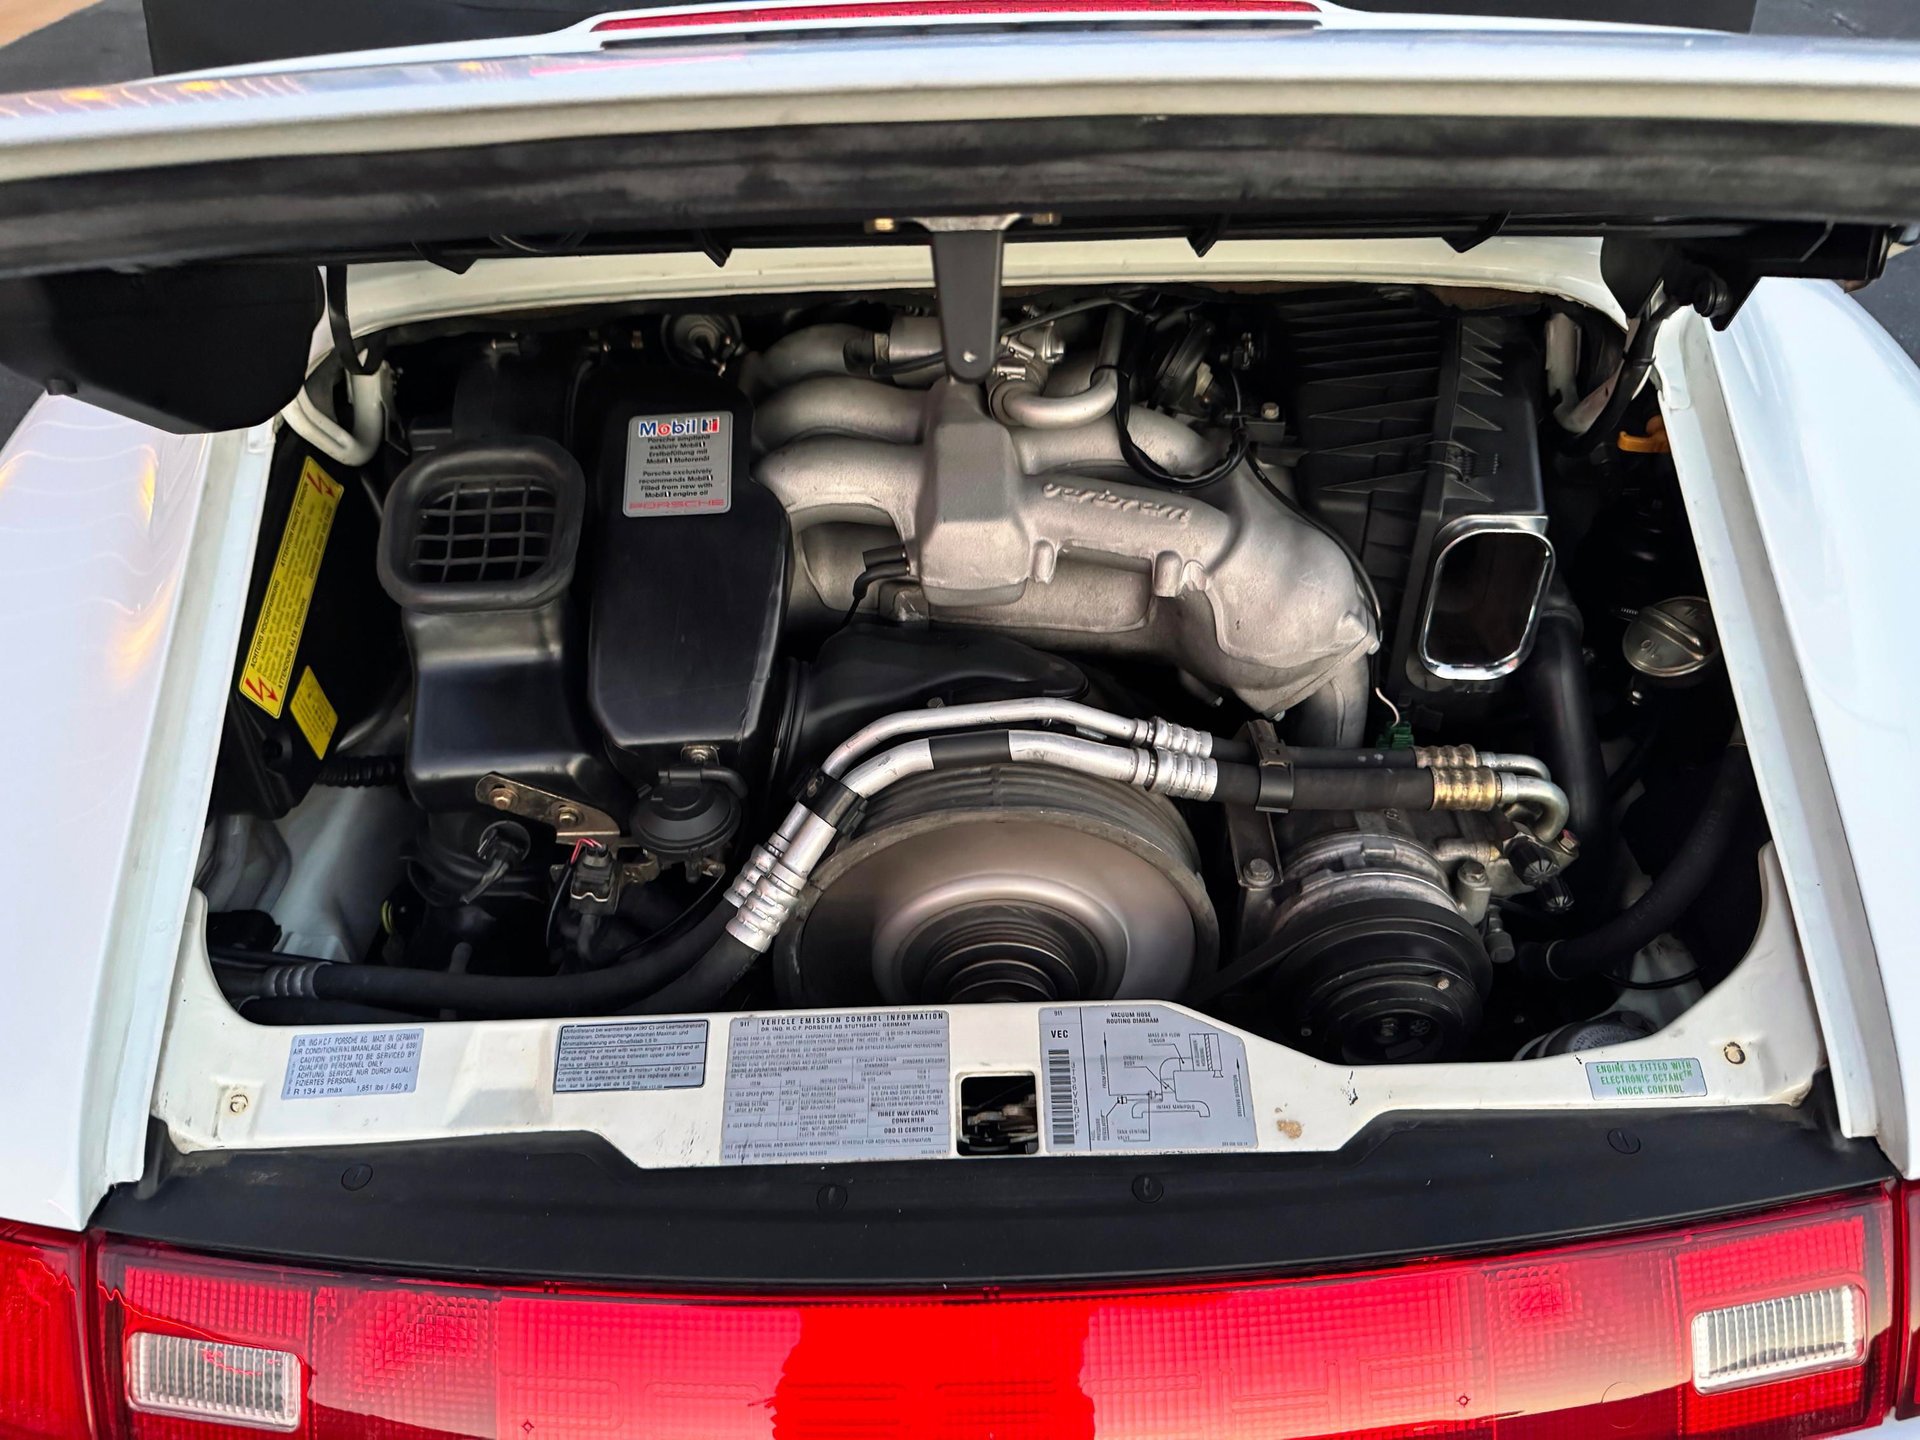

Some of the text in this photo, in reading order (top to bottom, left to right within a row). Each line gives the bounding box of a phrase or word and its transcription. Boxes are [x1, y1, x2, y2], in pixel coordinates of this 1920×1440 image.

[638, 418, 698, 438] Mobil
[648, 436, 675, 444] Porsche
[650, 442, 678, 450] exklusiv
[673, 468, 712, 476] exclusively
[628, 498, 724, 510] PORSCHE
[250, 635, 266, 669] ACHTUNG
[761, 1012, 944, 1026] VEHICLE EMISSION CONTROL INFORMATION
[335, 1036, 358, 1046] PORSCHE
[372, 1034, 386, 1043] MADE
[396, 1033, 420, 1042] GERMANY
[1050, 1030, 1068, 1038] VEC
[293, 1048, 302, 1056] AIR
[300, 1056, 326, 1064] CAUTION
[330, 1054, 353, 1062] SYSTEM
[366, 1052, 373, 1060] BE
[377, 1051, 406, 1060] SERVICED
[408, 1050, 416, 1058] BY
[298, 1060, 384, 1072] QUALIFIED PERSONNEL ONLY
[1596, 1060, 1692, 1074] ENGINE IS FITTED WITH
[296, 1071, 325, 1080] ACHTUNG
[329, 1069, 353, 1078] SERVICE
[356, 1068, 369, 1076] NUR
[371, 1067, 392, 1076] DURCH
[1600, 1074, 1650, 1085] ELECTRONIC
[296, 1076, 356, 1087] FIZIERTES PERSONAL
[294, 1088, 300, 1096] R
[304, 1087, 316, 1095] 134
[375, 1084, 384, 1092] lbs
[1616, 1084, 1686, 1096] KNOCK CONTROL
[878, 1110, 896, 1118] THREE
[904, 1126, 934, 1134] CERTIFIED
